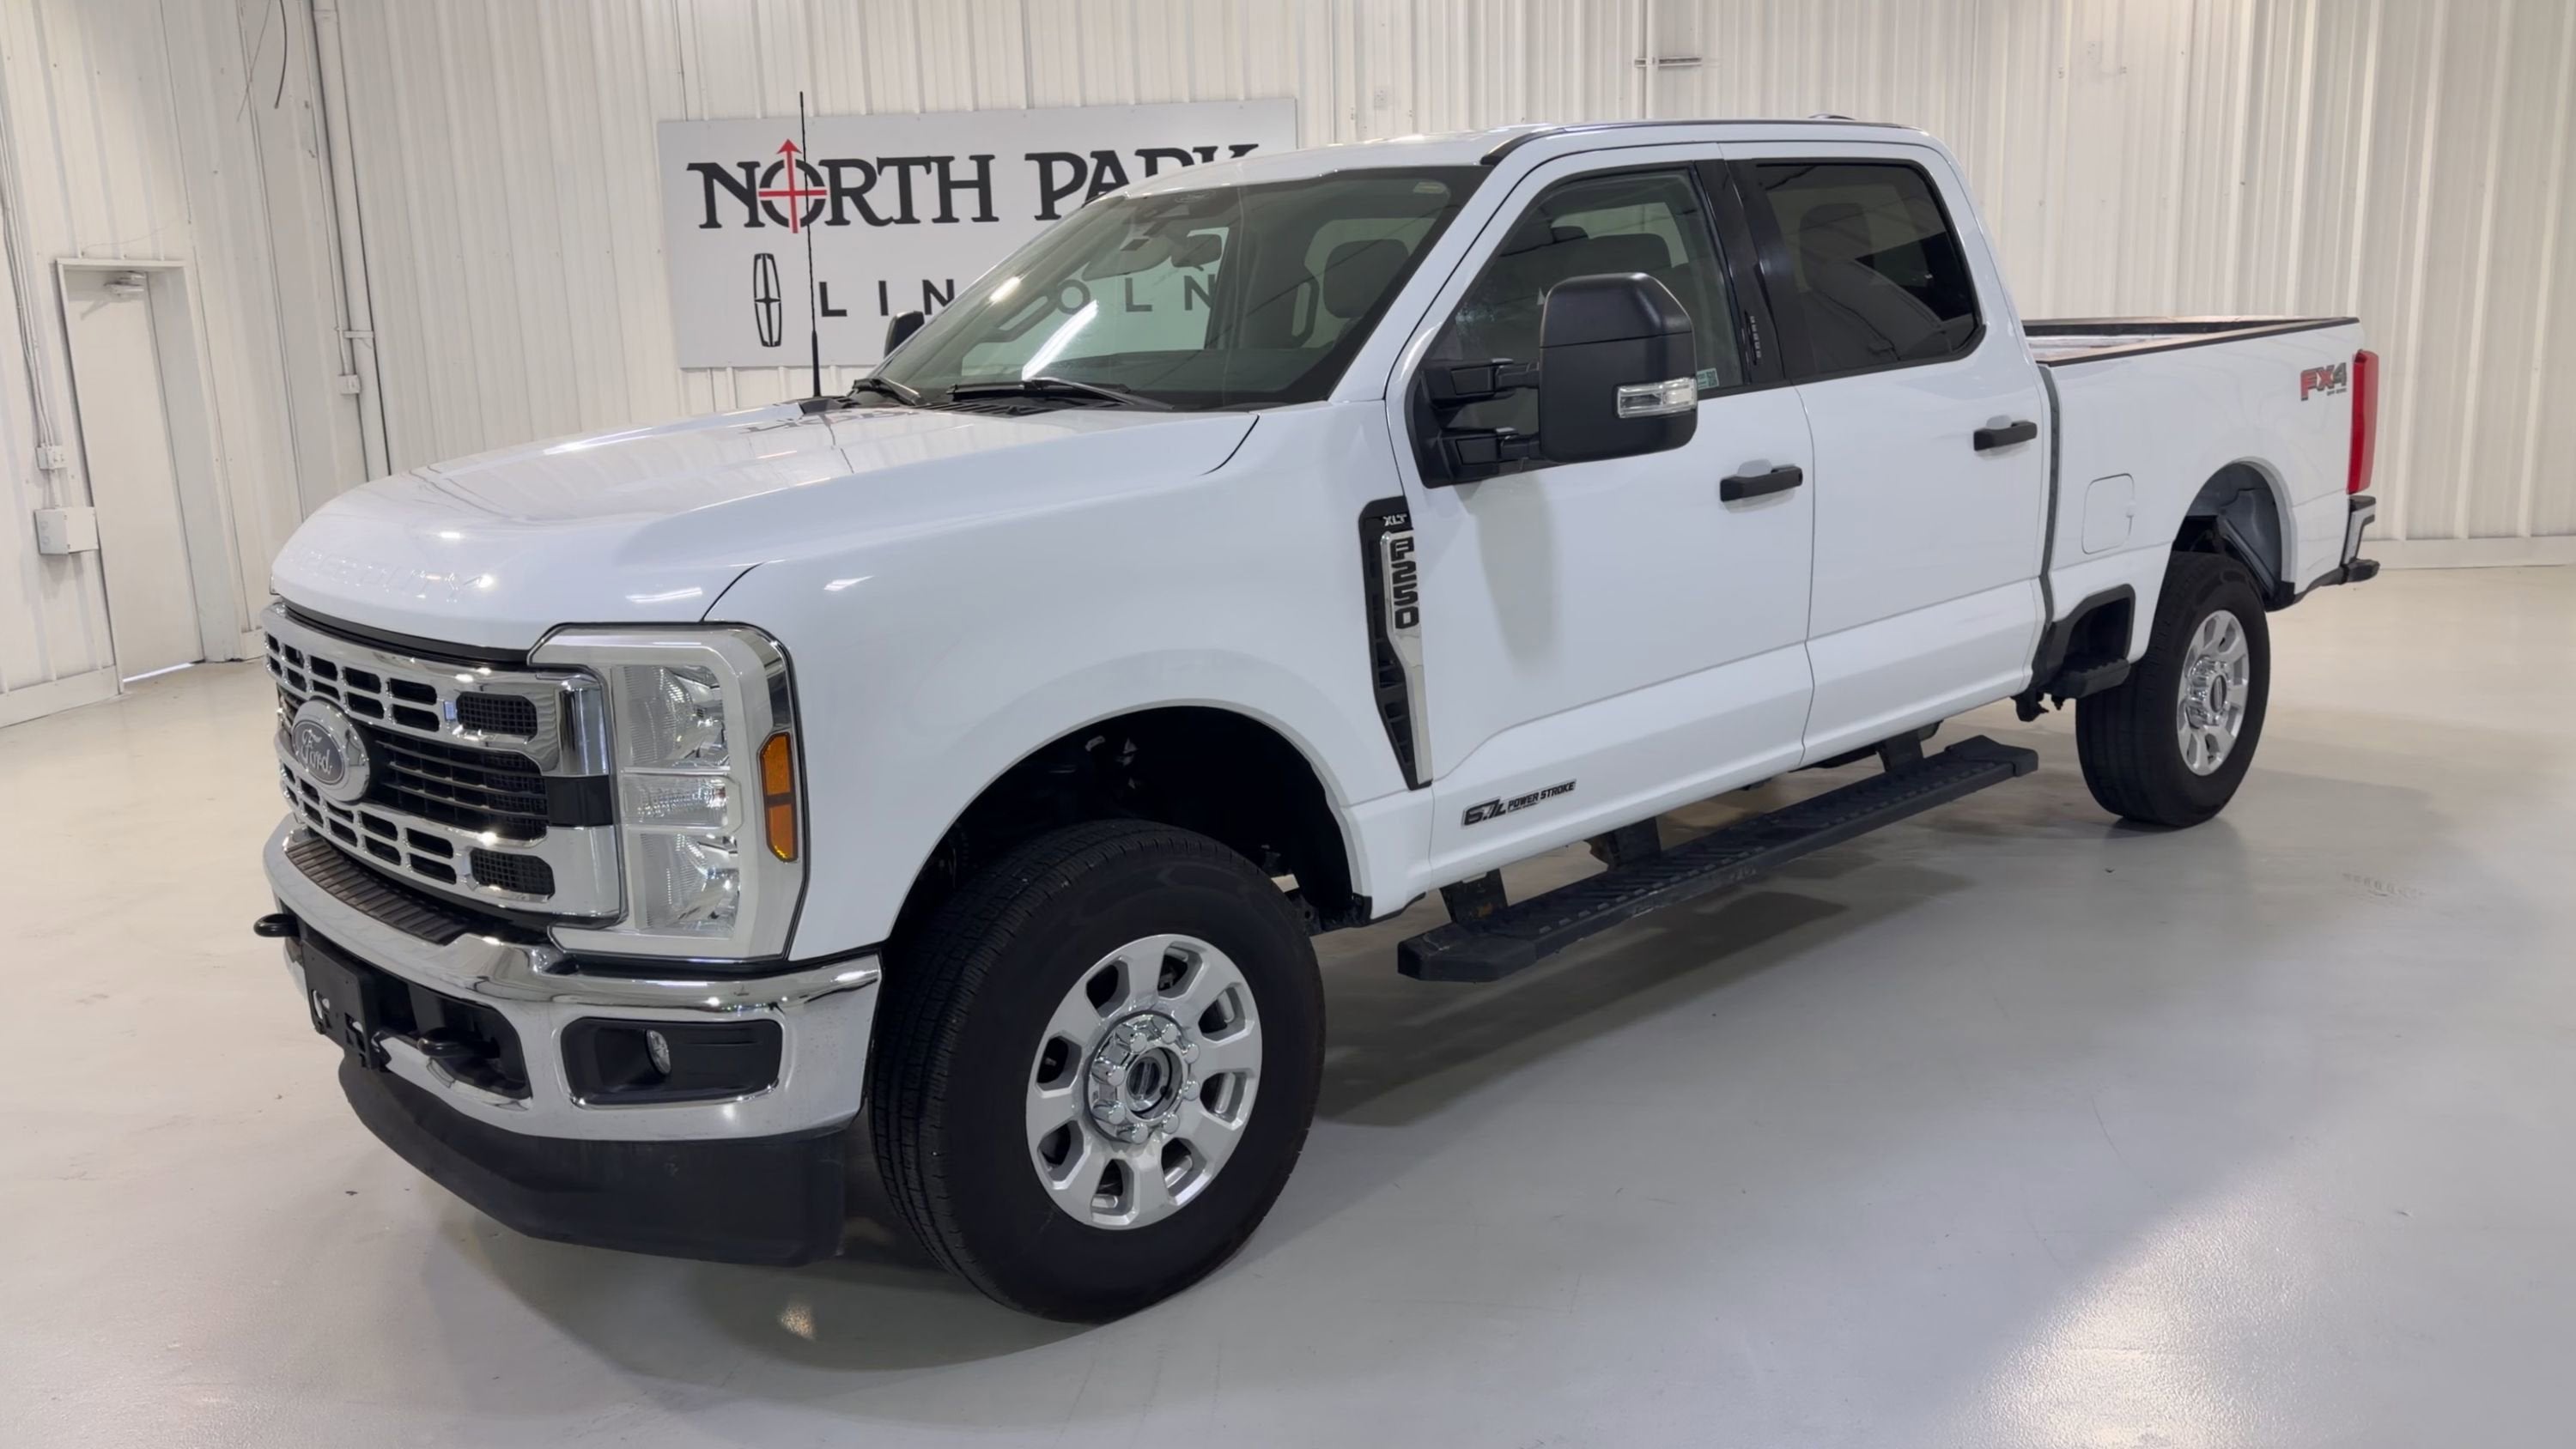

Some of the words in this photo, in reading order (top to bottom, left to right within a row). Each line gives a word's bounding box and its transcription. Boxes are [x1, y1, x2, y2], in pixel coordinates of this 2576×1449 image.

[687, 155, 999, 228] NORTH
[1024, 143, 1259, 221] PA
[818, 274, 1217, 317] LINOLN
[2300, 362, 2347, 401] FX4
[1382, 513, 1407, 526] XLT
[1389, 536, 1419, 629] F250
[301, 730, 333, 774] Ford
[1463, 798, 1506, 826] 6.7L
[1508, 792, 1540, 808] POWER
[1540, 781, 1576, 800] STROKE
